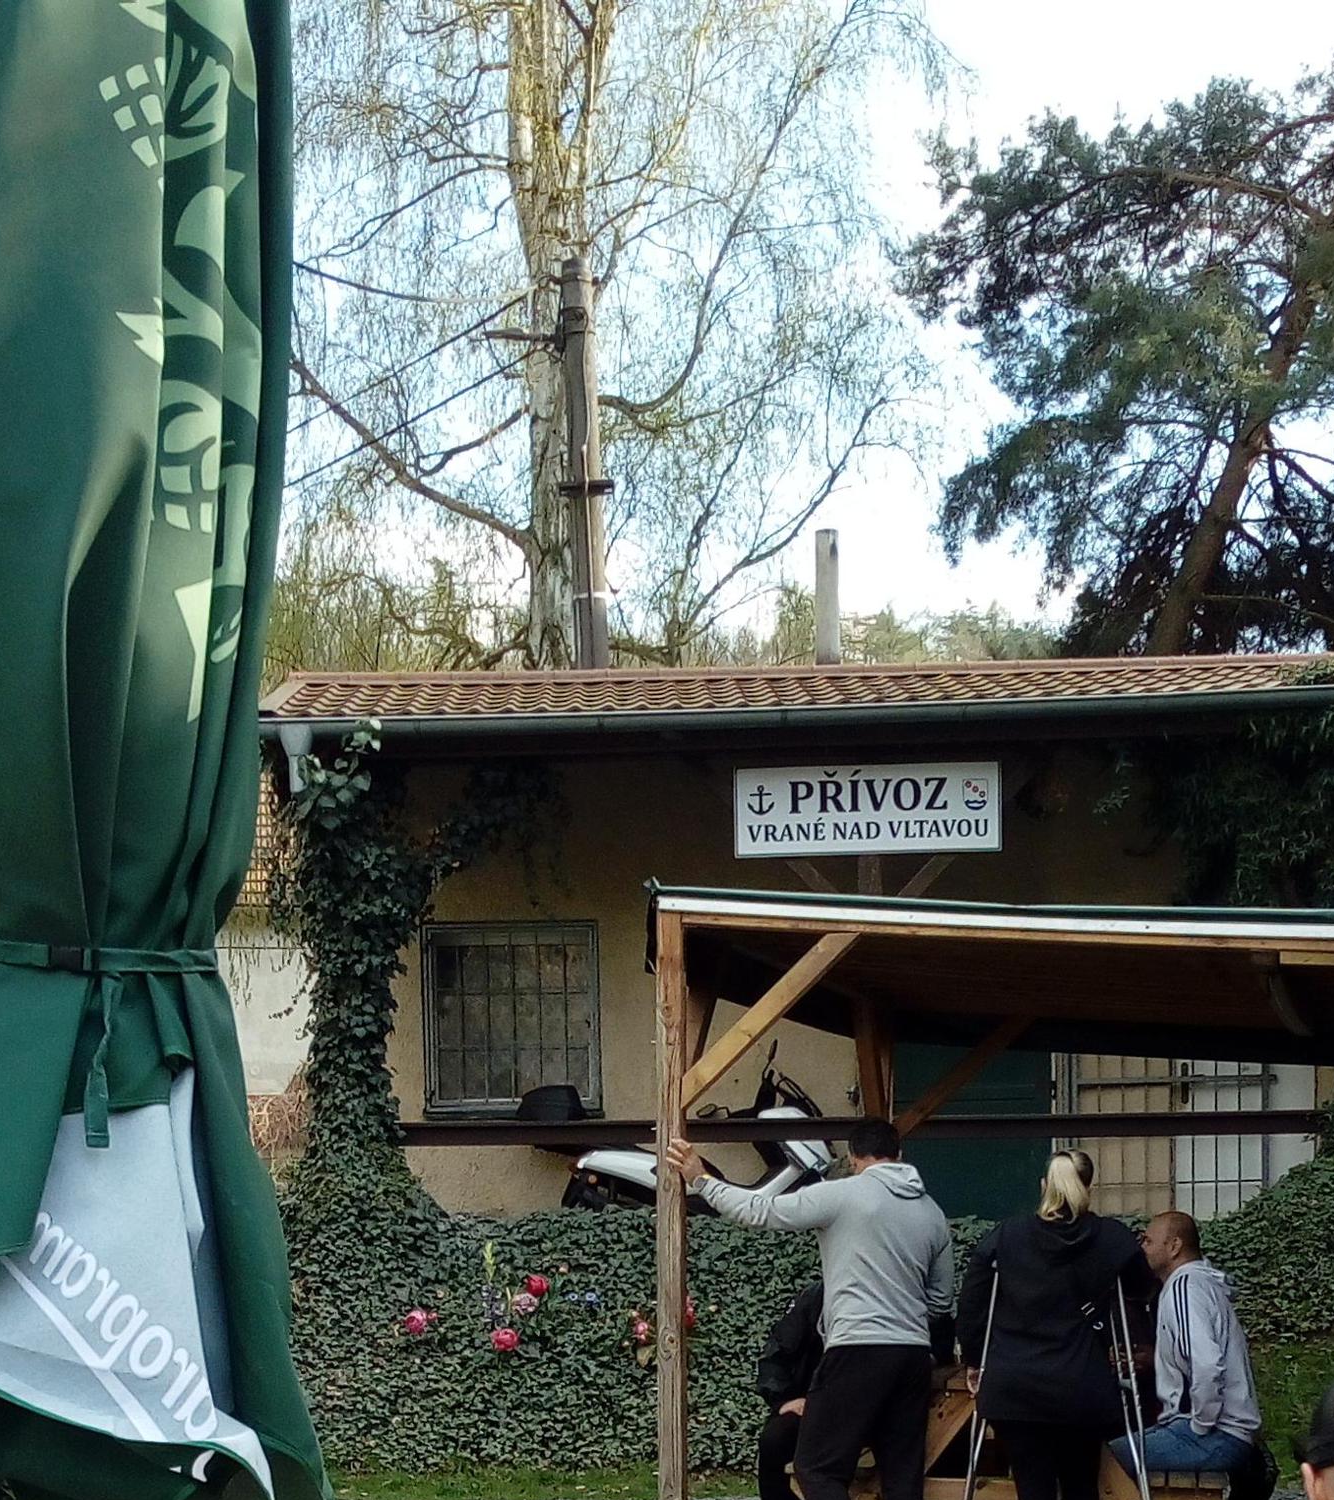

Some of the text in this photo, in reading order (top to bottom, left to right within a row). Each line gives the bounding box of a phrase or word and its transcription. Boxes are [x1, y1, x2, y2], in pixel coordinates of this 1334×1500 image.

[788, 769, 948, 814] PŘÍVOZ
[747, 818, 990, 843] VRANÉ NAD VLTAVOU
